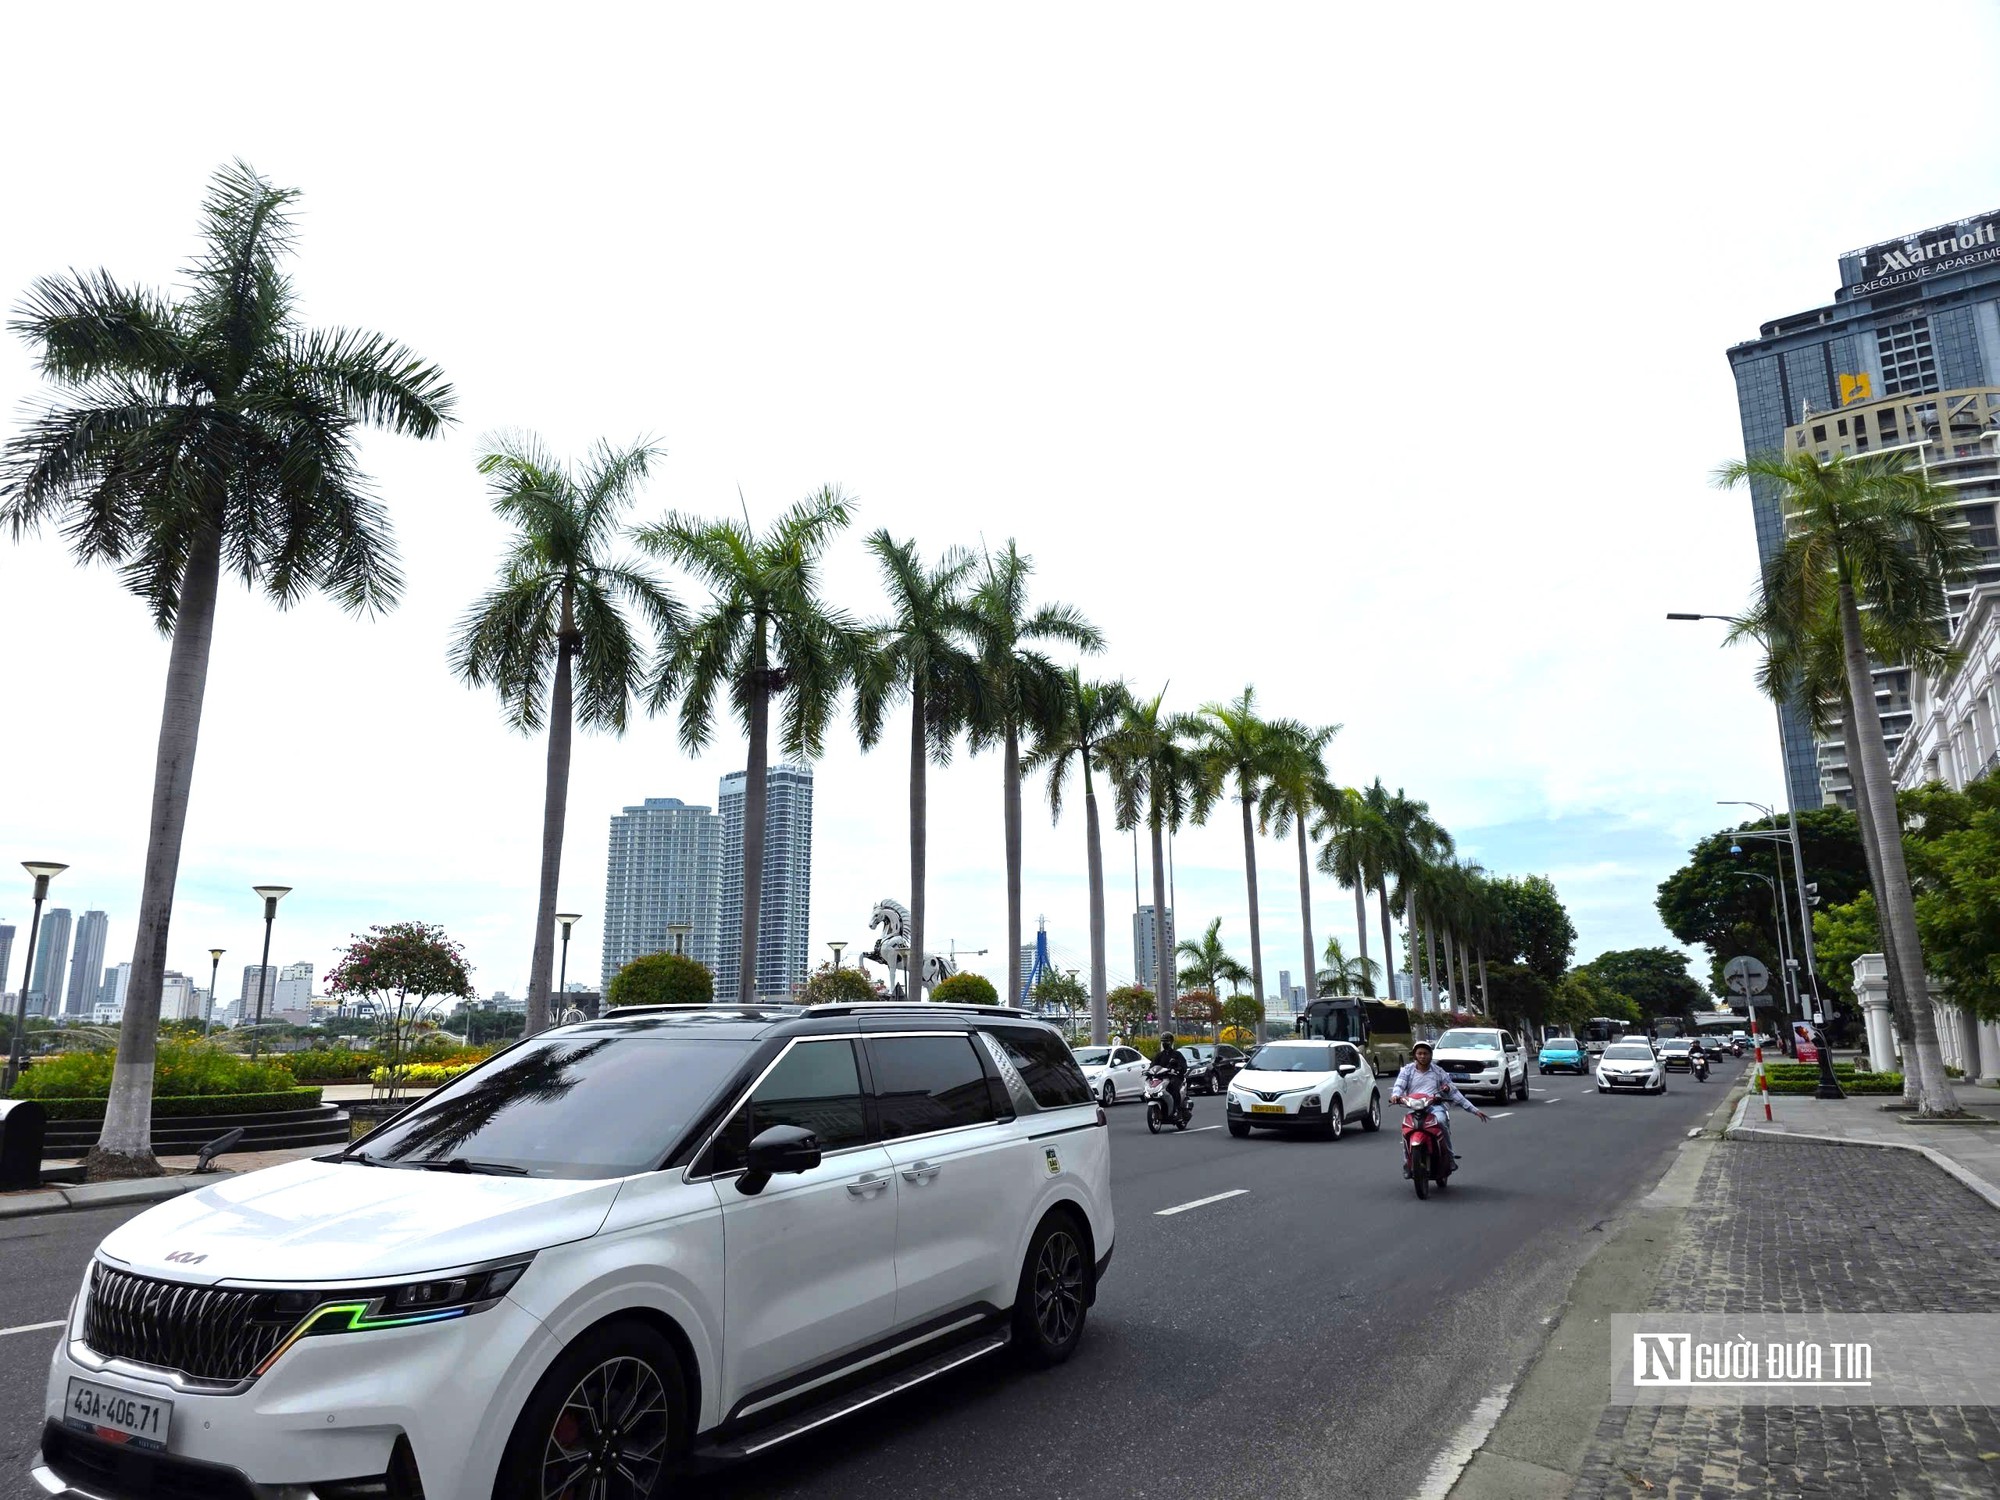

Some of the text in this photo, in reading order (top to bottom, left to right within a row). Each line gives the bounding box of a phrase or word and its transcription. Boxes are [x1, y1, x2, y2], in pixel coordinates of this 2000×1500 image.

[1877, 223, 1996, 277] Marriott
[1852, 266, 1931, 294] EXECUTIVE
[164, 1250, 209, 1265] KIA
[74, 1388, 160, 1433] 43A-406.71
